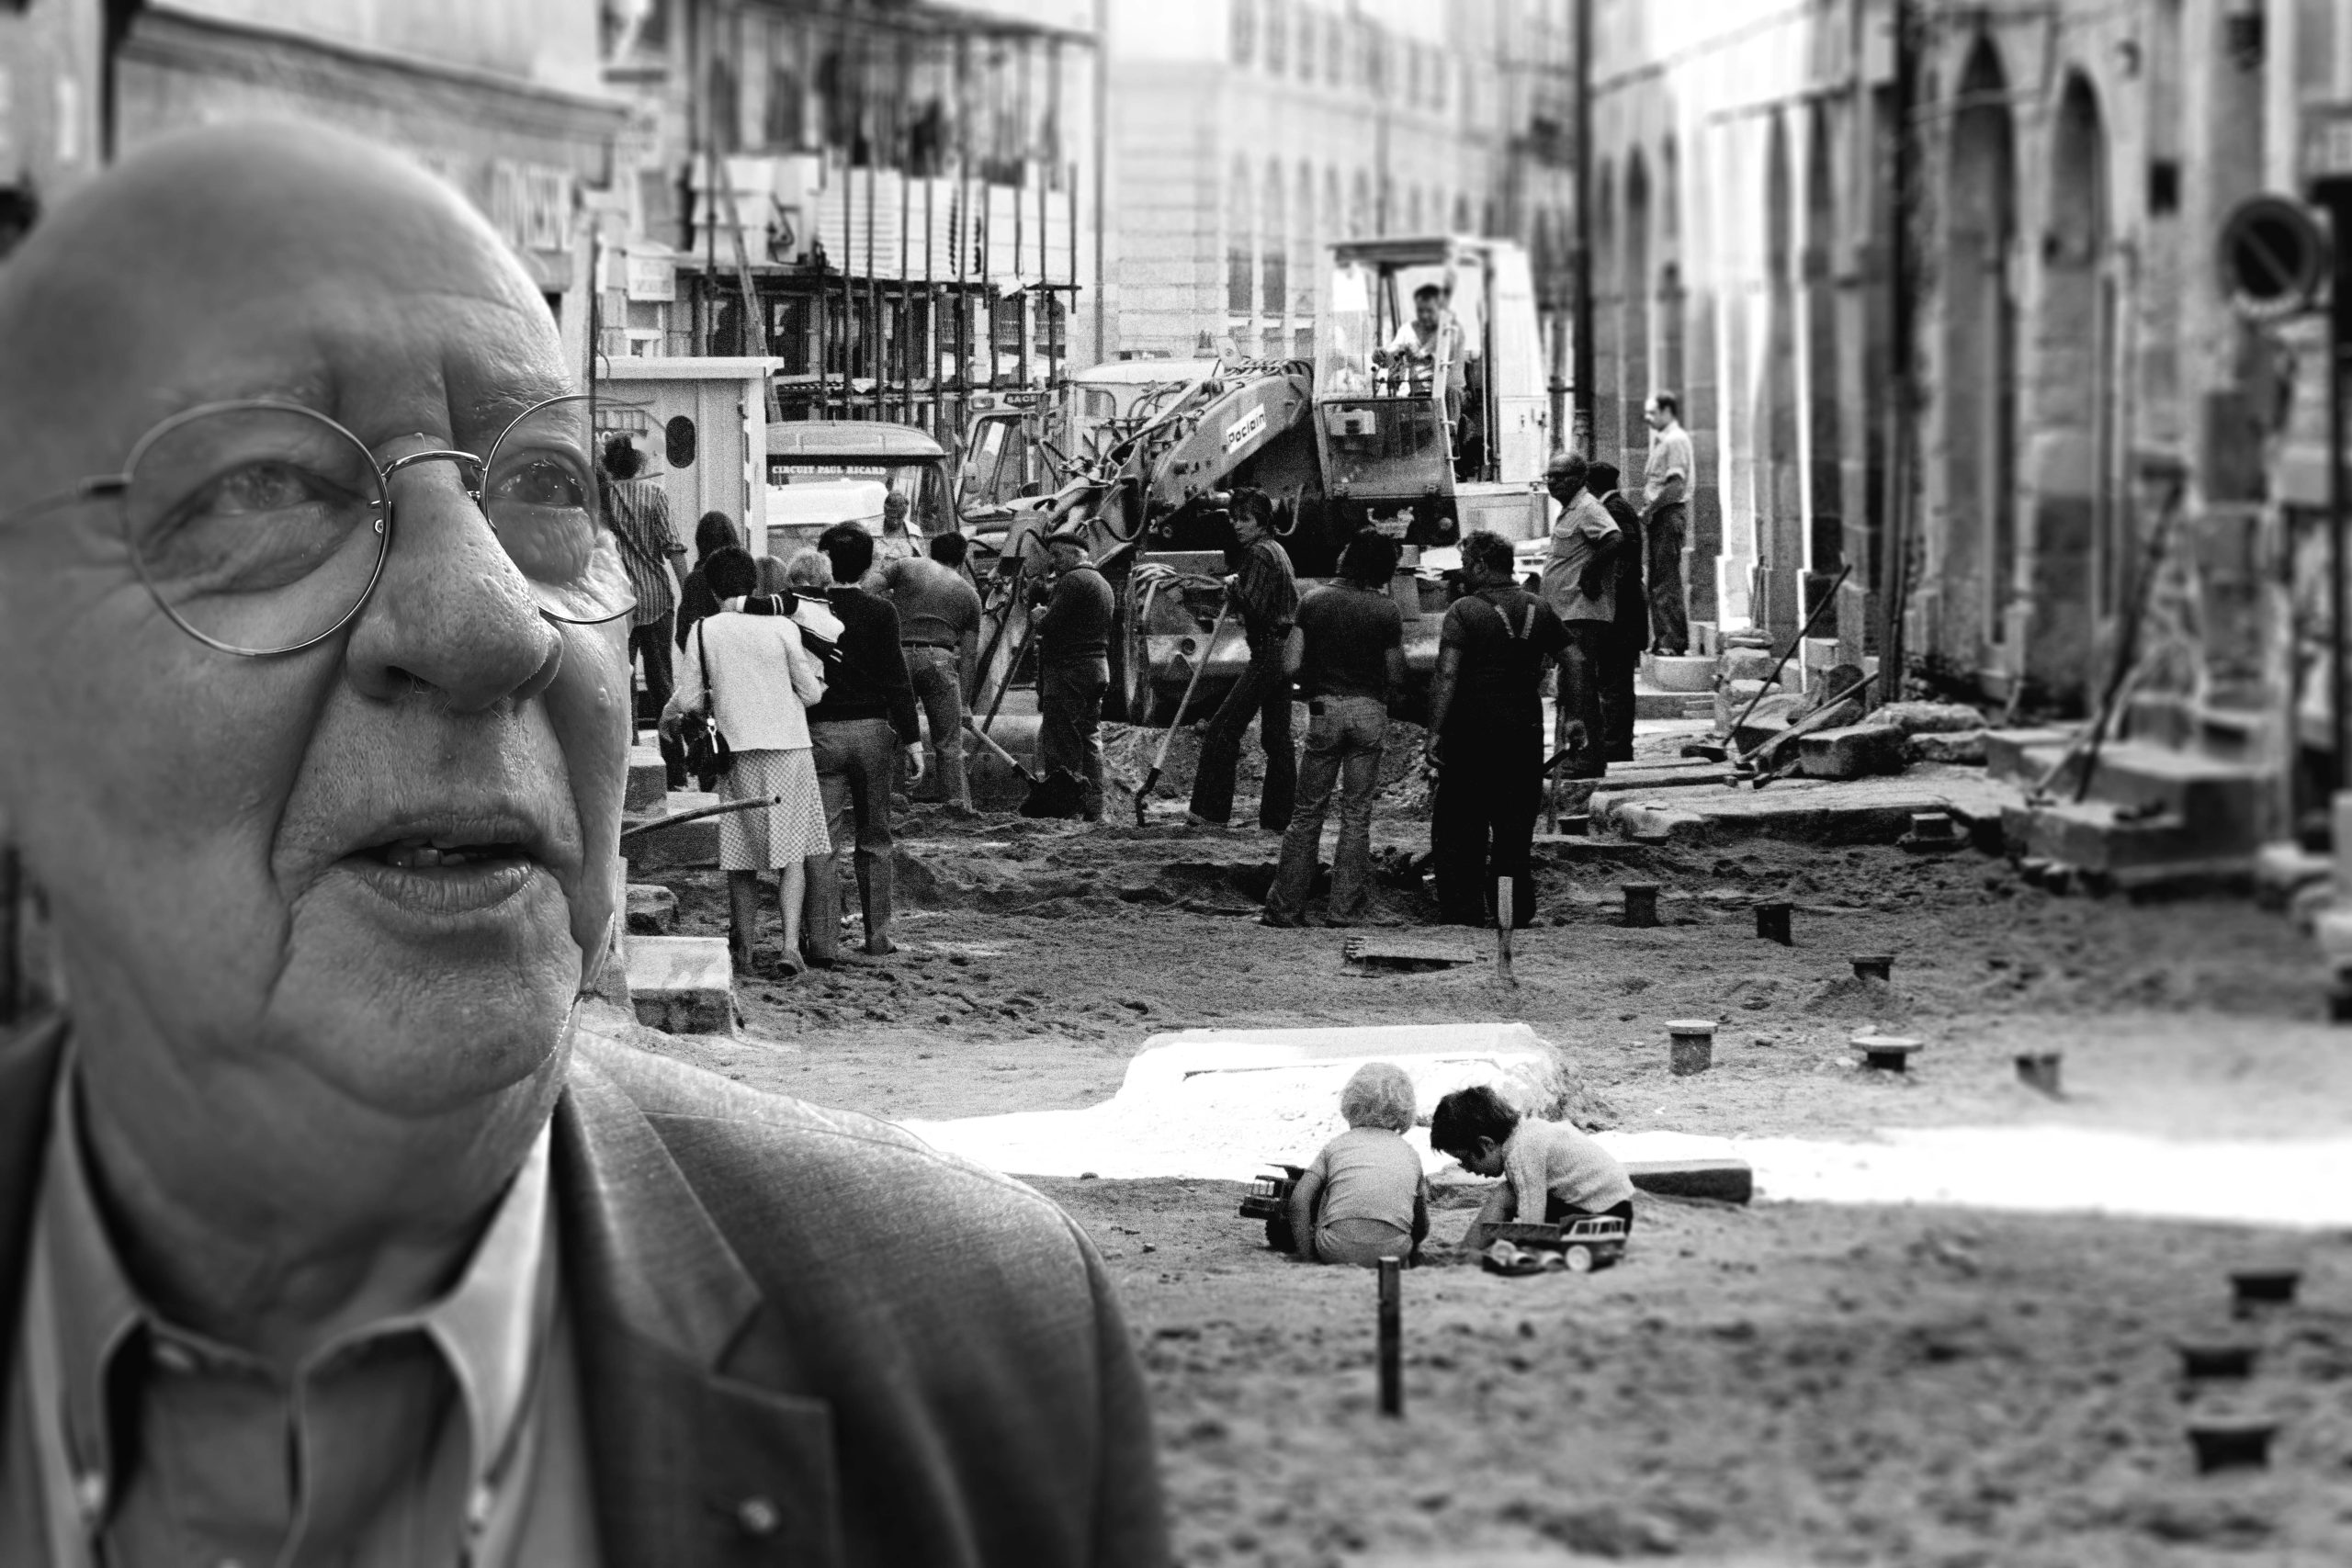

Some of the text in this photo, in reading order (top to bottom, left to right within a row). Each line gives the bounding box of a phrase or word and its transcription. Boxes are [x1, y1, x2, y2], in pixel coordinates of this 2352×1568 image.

[772, 465, 887, 475] CIRCUIT PAUL RICARD
